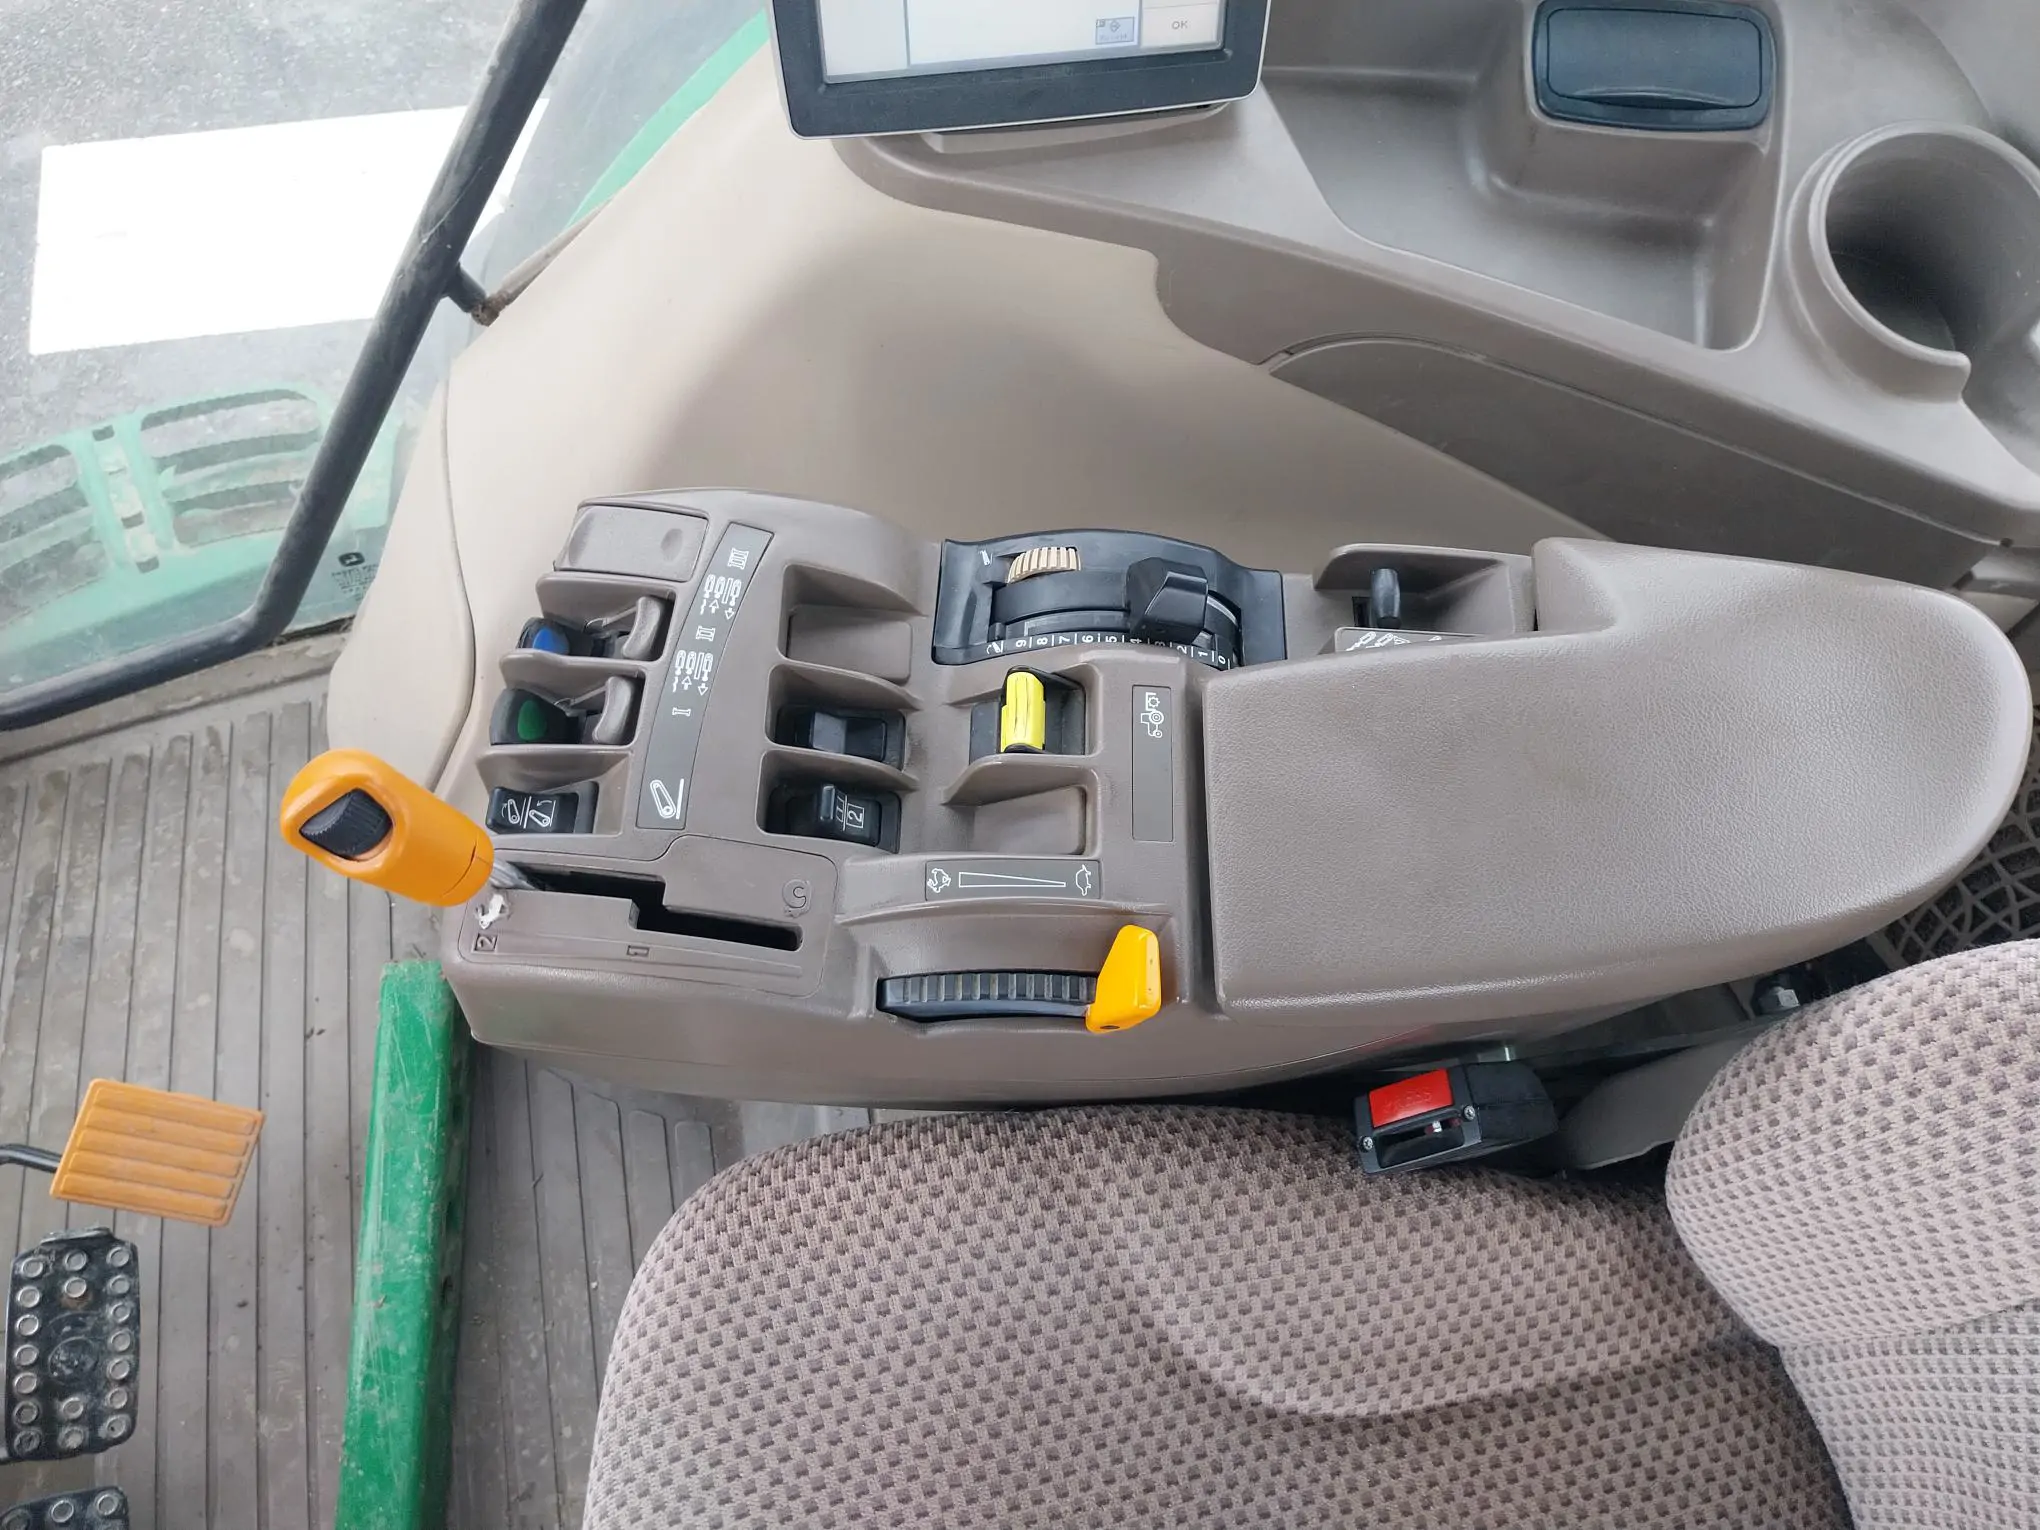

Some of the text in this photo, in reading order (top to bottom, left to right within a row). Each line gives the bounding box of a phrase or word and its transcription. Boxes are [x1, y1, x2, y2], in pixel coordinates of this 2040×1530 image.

[1171, 20, 1188, 30] OK
[1015, 639, 1027, 648] 9
[1036, 636, 1049, 646] 8
[1058, 635, 1071, 645] 7
[1081, 634, 1094, 644] 6
[1104, 635, 1118, 644] 5
[1176, 645, 1188, 655] 2
[1197, 650, 1209, 658] 1
[1217, 655, 1227, 665] 0
[847, 810, 863, 823] 2
[476, 935, 496, 951] 2
